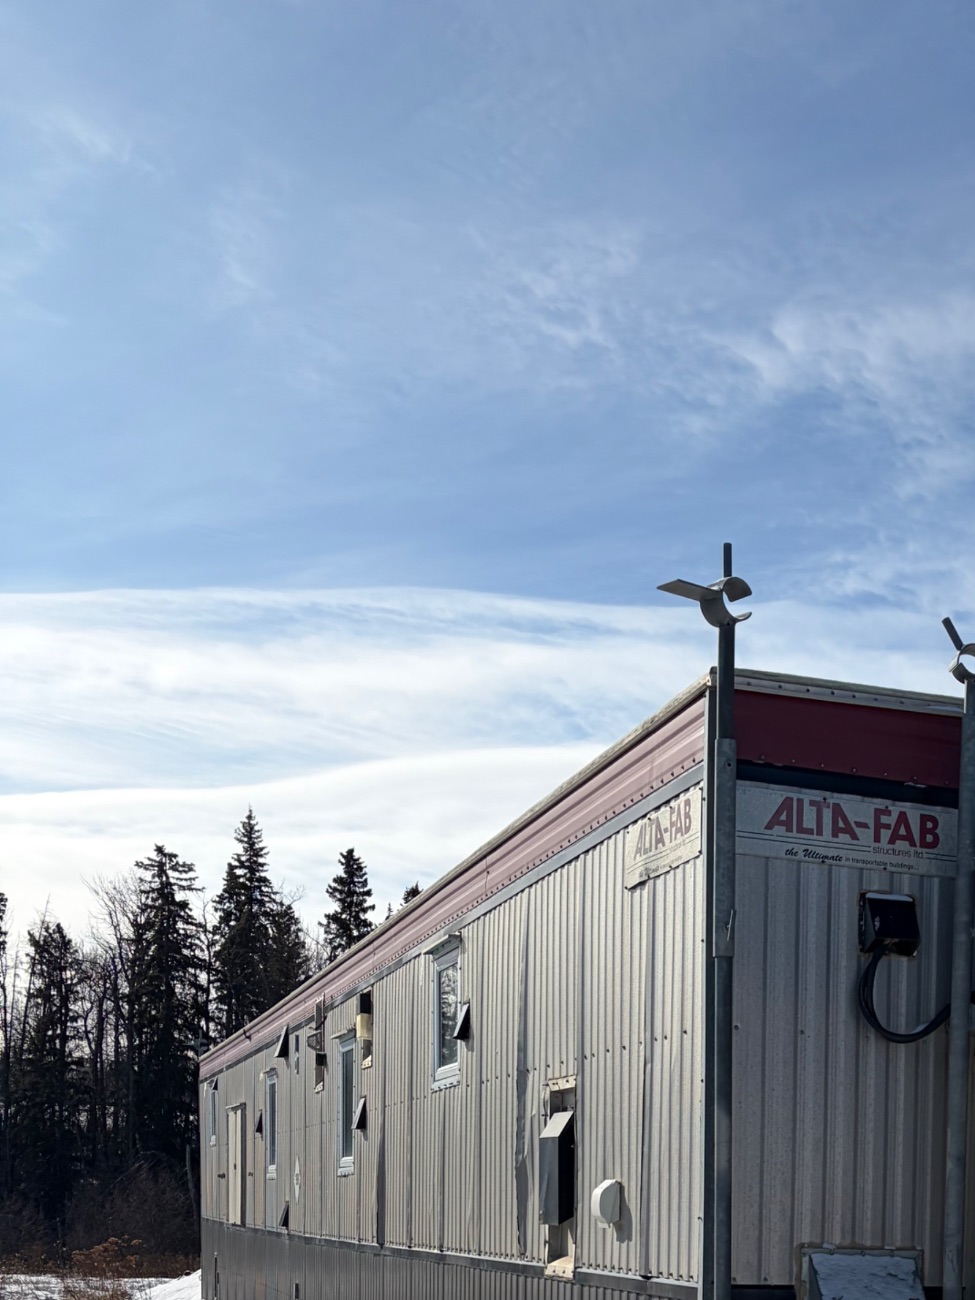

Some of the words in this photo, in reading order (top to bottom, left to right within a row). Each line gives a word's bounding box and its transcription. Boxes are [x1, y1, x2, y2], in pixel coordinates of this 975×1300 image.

[633, 797, 692, 861] ALTA-FAB
[764, 796, 940, 850] ALTA-FAB
[784, 847, 798, 858] the
[802, 848, 843, 863] Ultimate
[851, 857, 888, 867] transportable
[872, 846, 912, 858] structures
